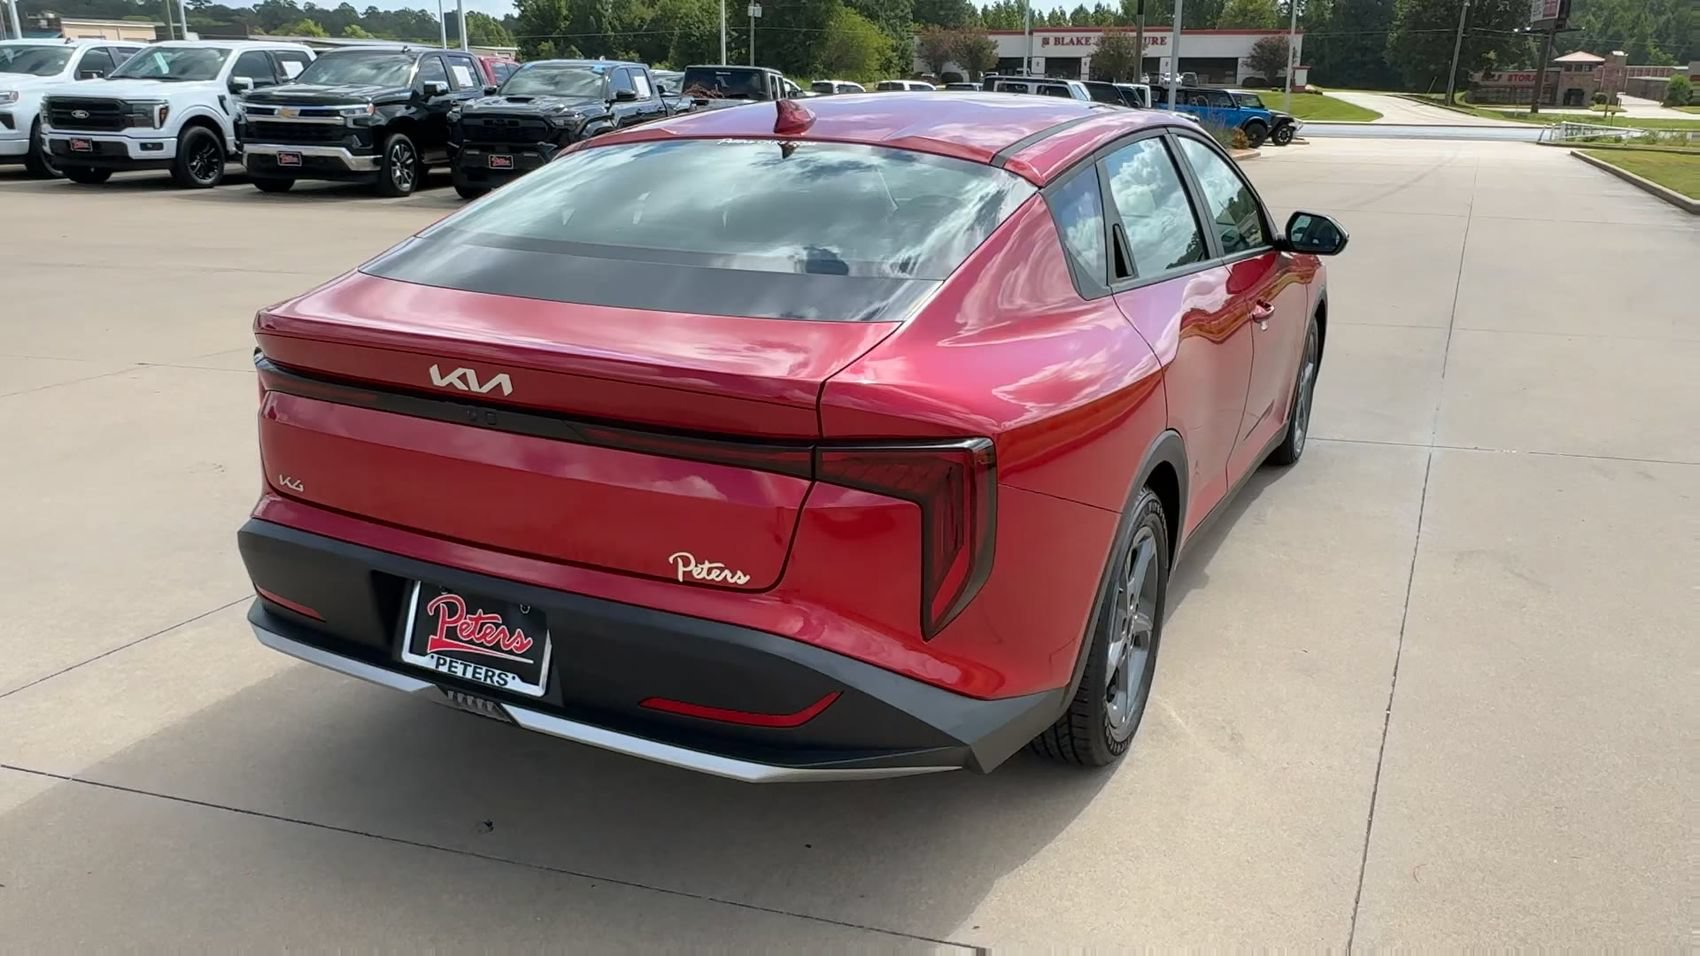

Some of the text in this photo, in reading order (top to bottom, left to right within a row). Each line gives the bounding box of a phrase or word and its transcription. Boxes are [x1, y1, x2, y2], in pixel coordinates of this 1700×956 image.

[428, 363, 514, 397] KIA
[278, 474, 305, 492] K4
[668, 551, 751, 585] Peters
[426, 593, 534, 654] Peters
[434, 656, 510, 687] PETERS
